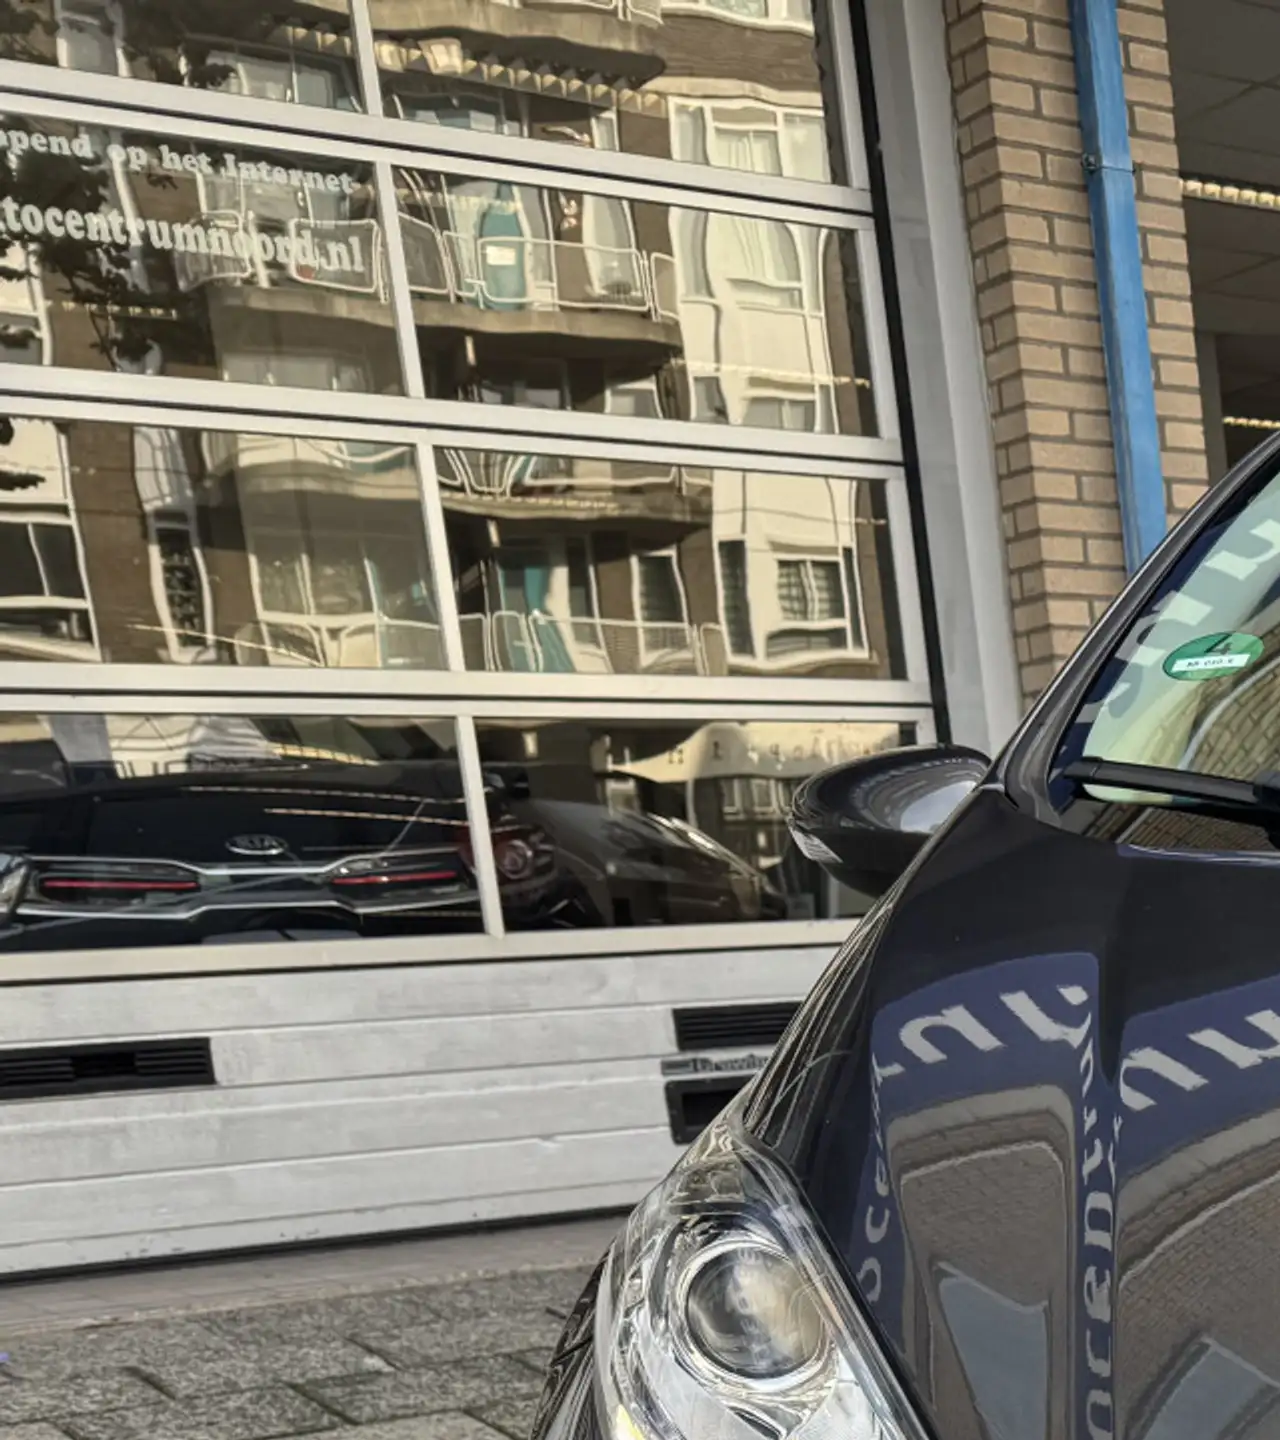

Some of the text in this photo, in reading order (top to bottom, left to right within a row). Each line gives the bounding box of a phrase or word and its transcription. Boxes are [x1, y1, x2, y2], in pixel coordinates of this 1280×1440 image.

[106, 144, 150, 171] op
[160, 144, 213, 176] het
[0, 196, 365, 273] tocentrumnoord.nl
